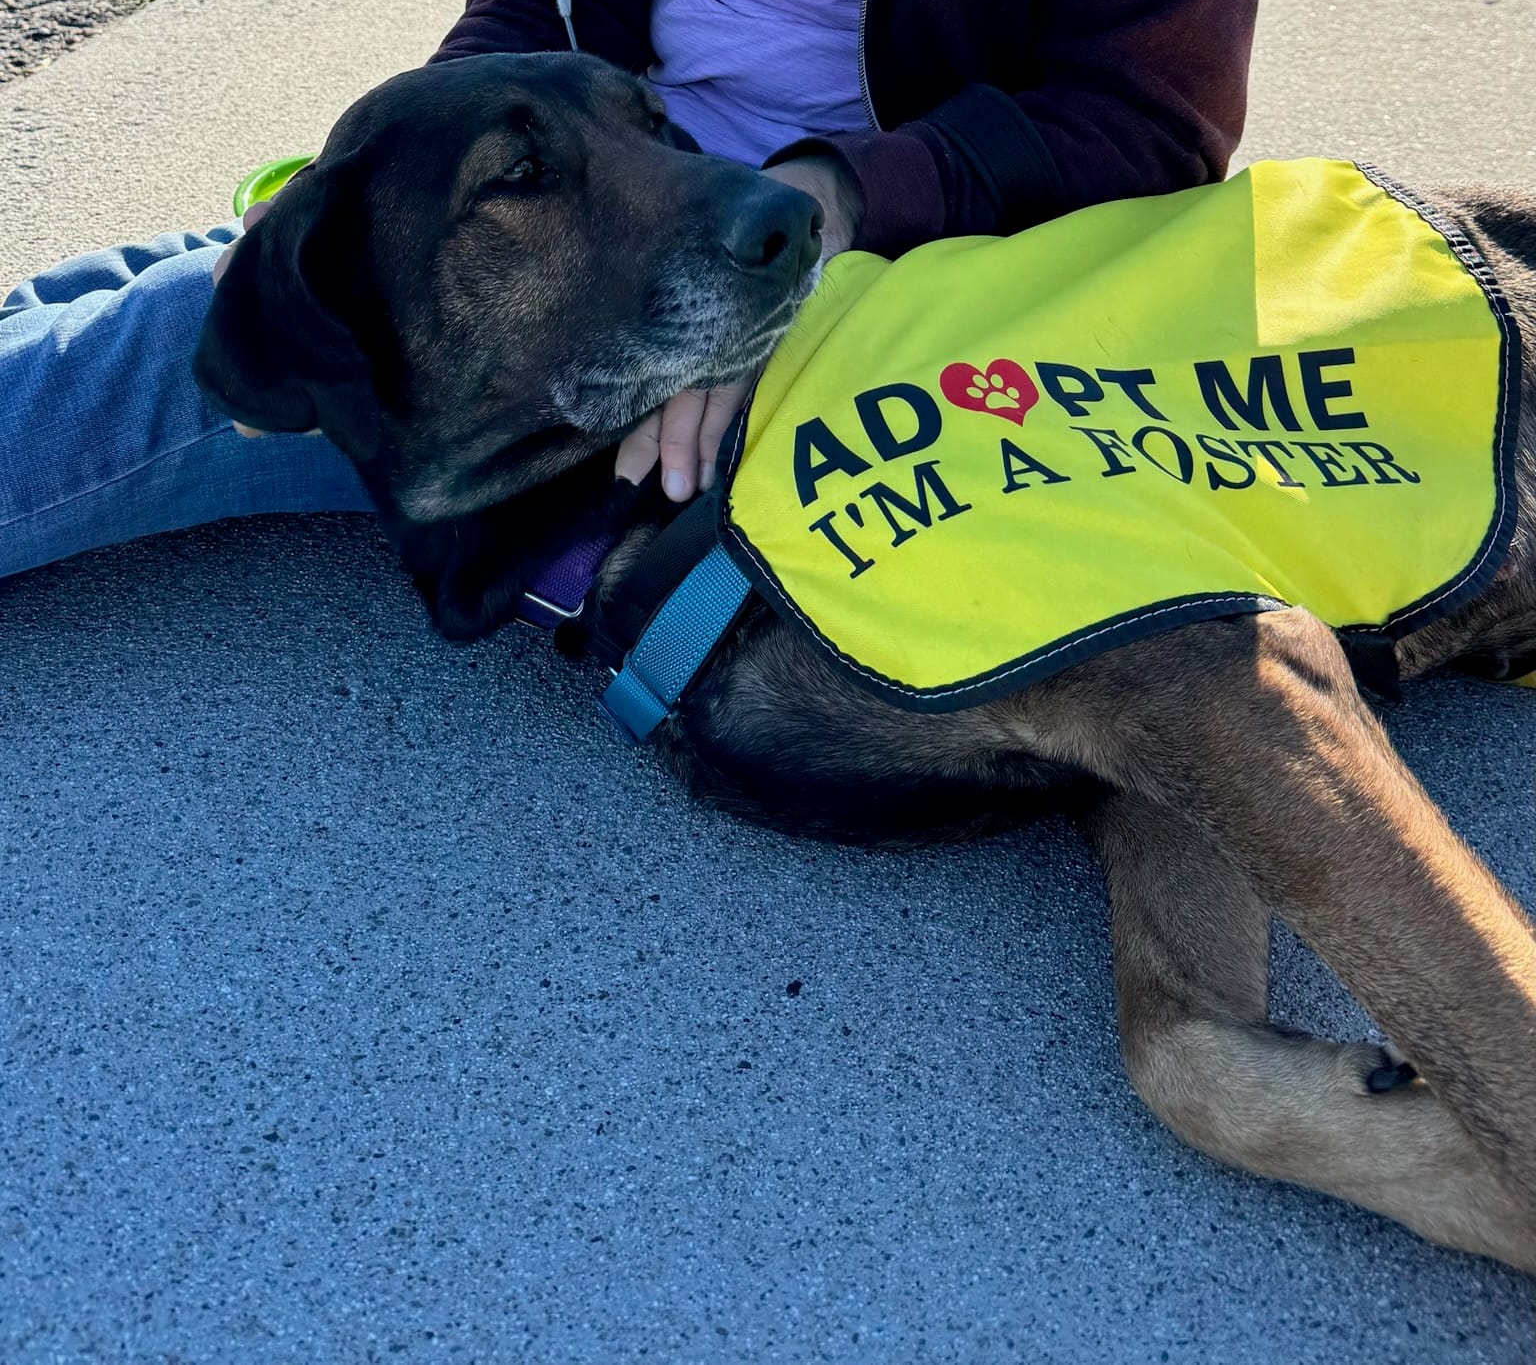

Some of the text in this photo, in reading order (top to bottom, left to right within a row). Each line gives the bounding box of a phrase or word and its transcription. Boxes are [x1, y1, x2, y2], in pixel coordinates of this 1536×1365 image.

[1193, 347, 1370, 432] ME
[808, 425, 1421, 580] I'M A FOSTER
